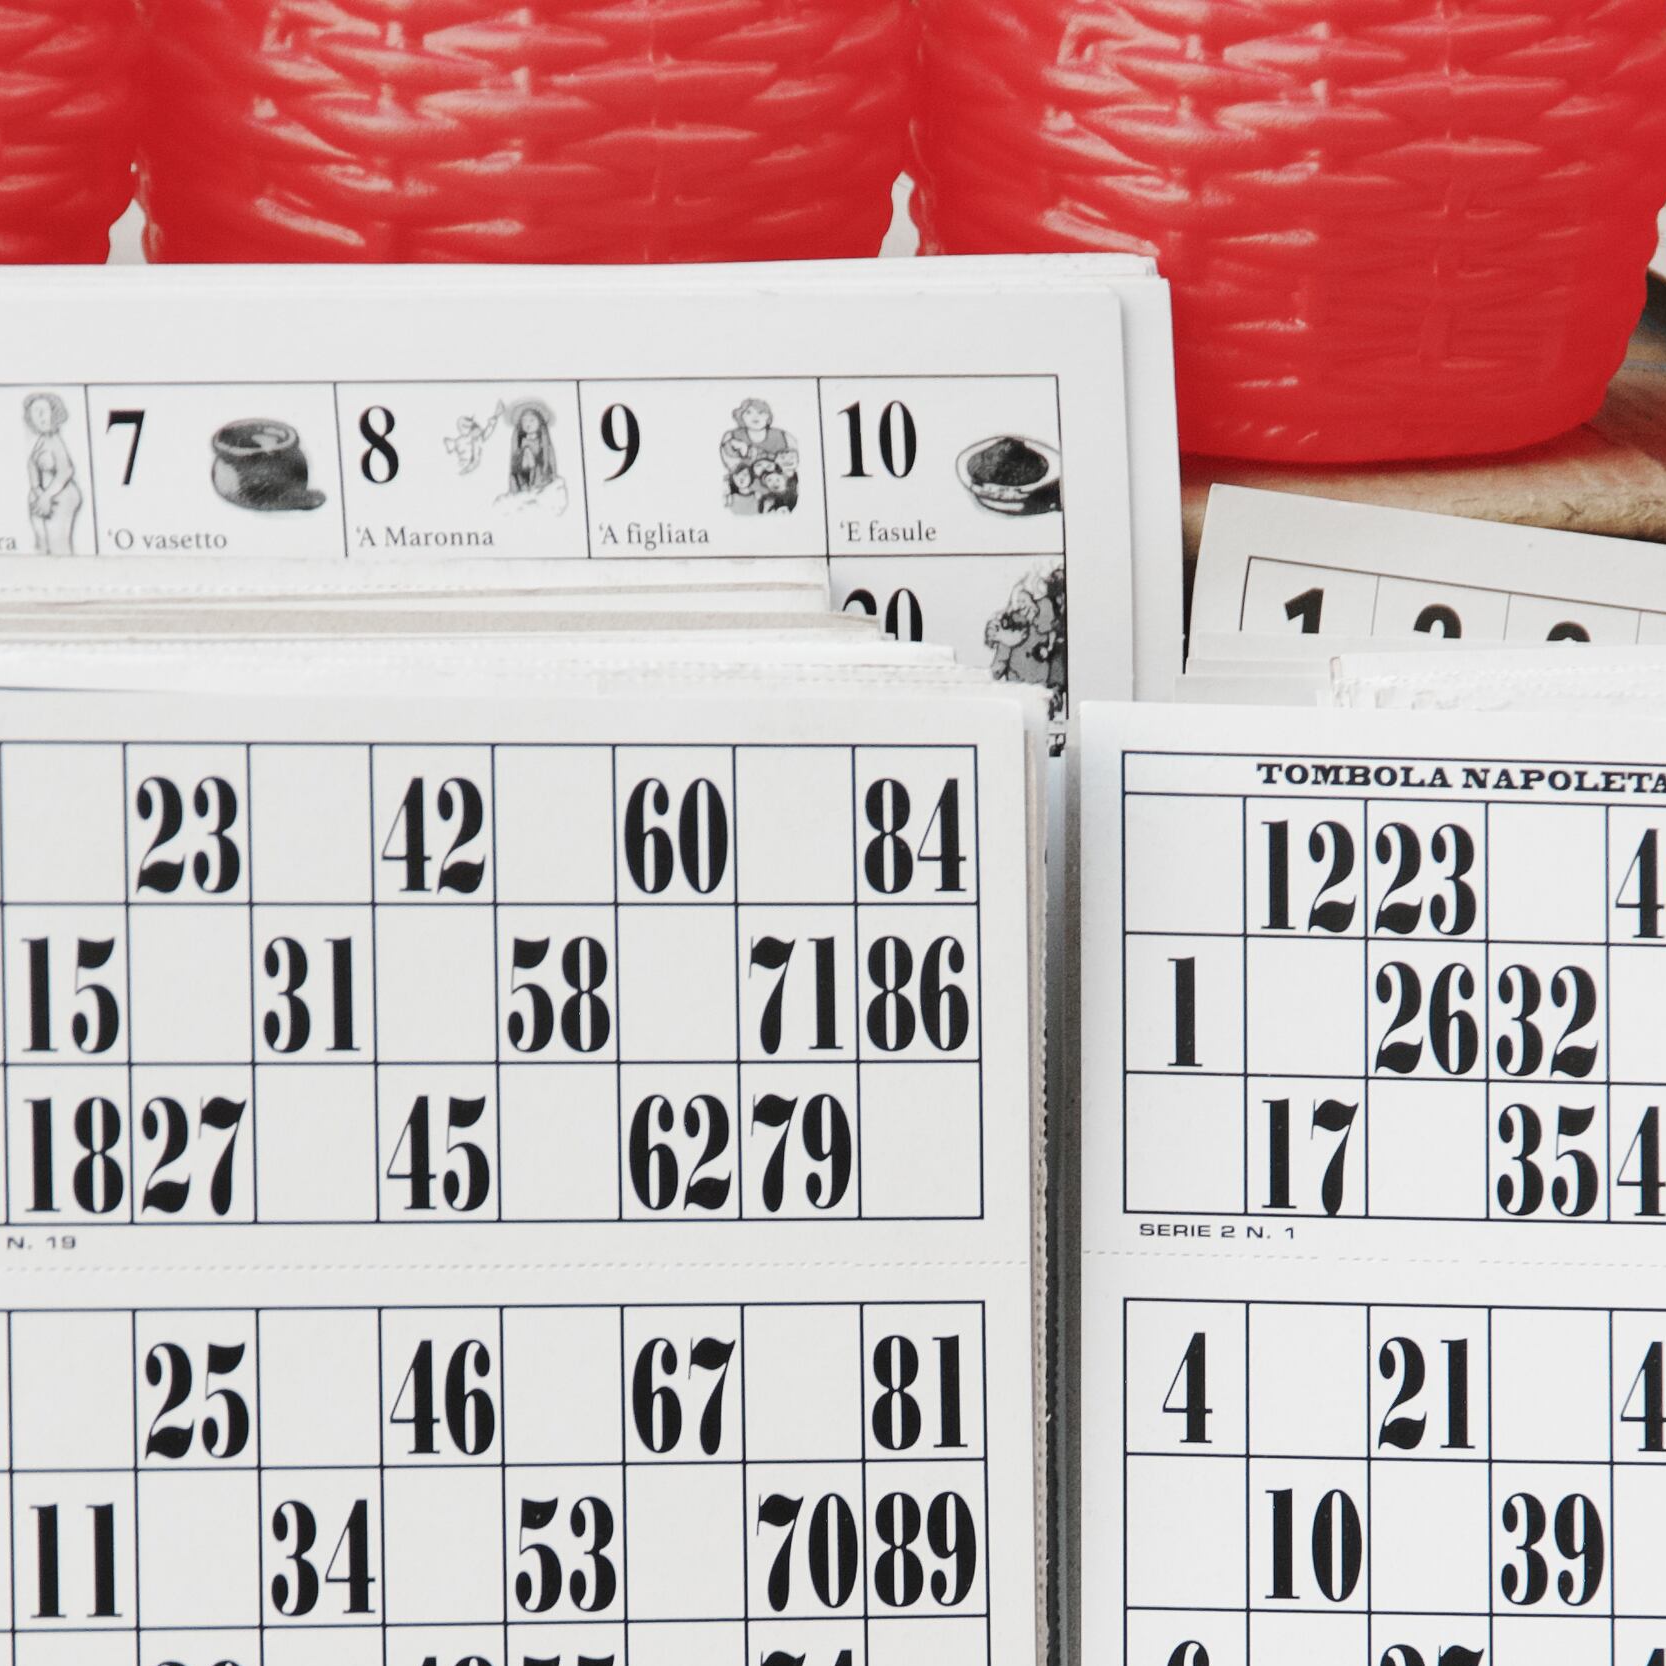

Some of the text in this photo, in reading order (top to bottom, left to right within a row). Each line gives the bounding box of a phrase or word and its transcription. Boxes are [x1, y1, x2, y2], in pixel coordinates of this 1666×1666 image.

[105, 409, 146, 486] 7
[359, 405, 399, 484] 8
[600, 403, 641, 483] 9
[836, 399, 917, 479] 10
[141, 530, 227, 550] vasetto
[384, 525, 494, 547] Maronna
[627, 521, 709, 550] figliata
[868, 520, 936, 543] fasule
[1255, 761, 1453, 790] TOMBOLA
[135, 775, 242, 895] 23
[381, 776, 486, 895] 42
[623, 777, 729, 895] 60
[863, 777, 968, 895] 84
[21, 935, 970, 1056] 15 31 58 71 86
[1167, 956, 1204, 1068] 1
[1374, 960, 1479, 1075] 26
[1496, 963, 1599, 1078] 32
[47, 1237, 76, 1250] 19
[1140, 1223, 1211, 1237] SERIE
[1161, 1331, 1214, 1444] 4
[1377, 1336, 1476, 1451] 21
[29, 1490, 977, 1619] 11 34 53 70 89
[1264, 1487, 1363, 1603] 10
[1500, 1491, 1605, 1607] 39
